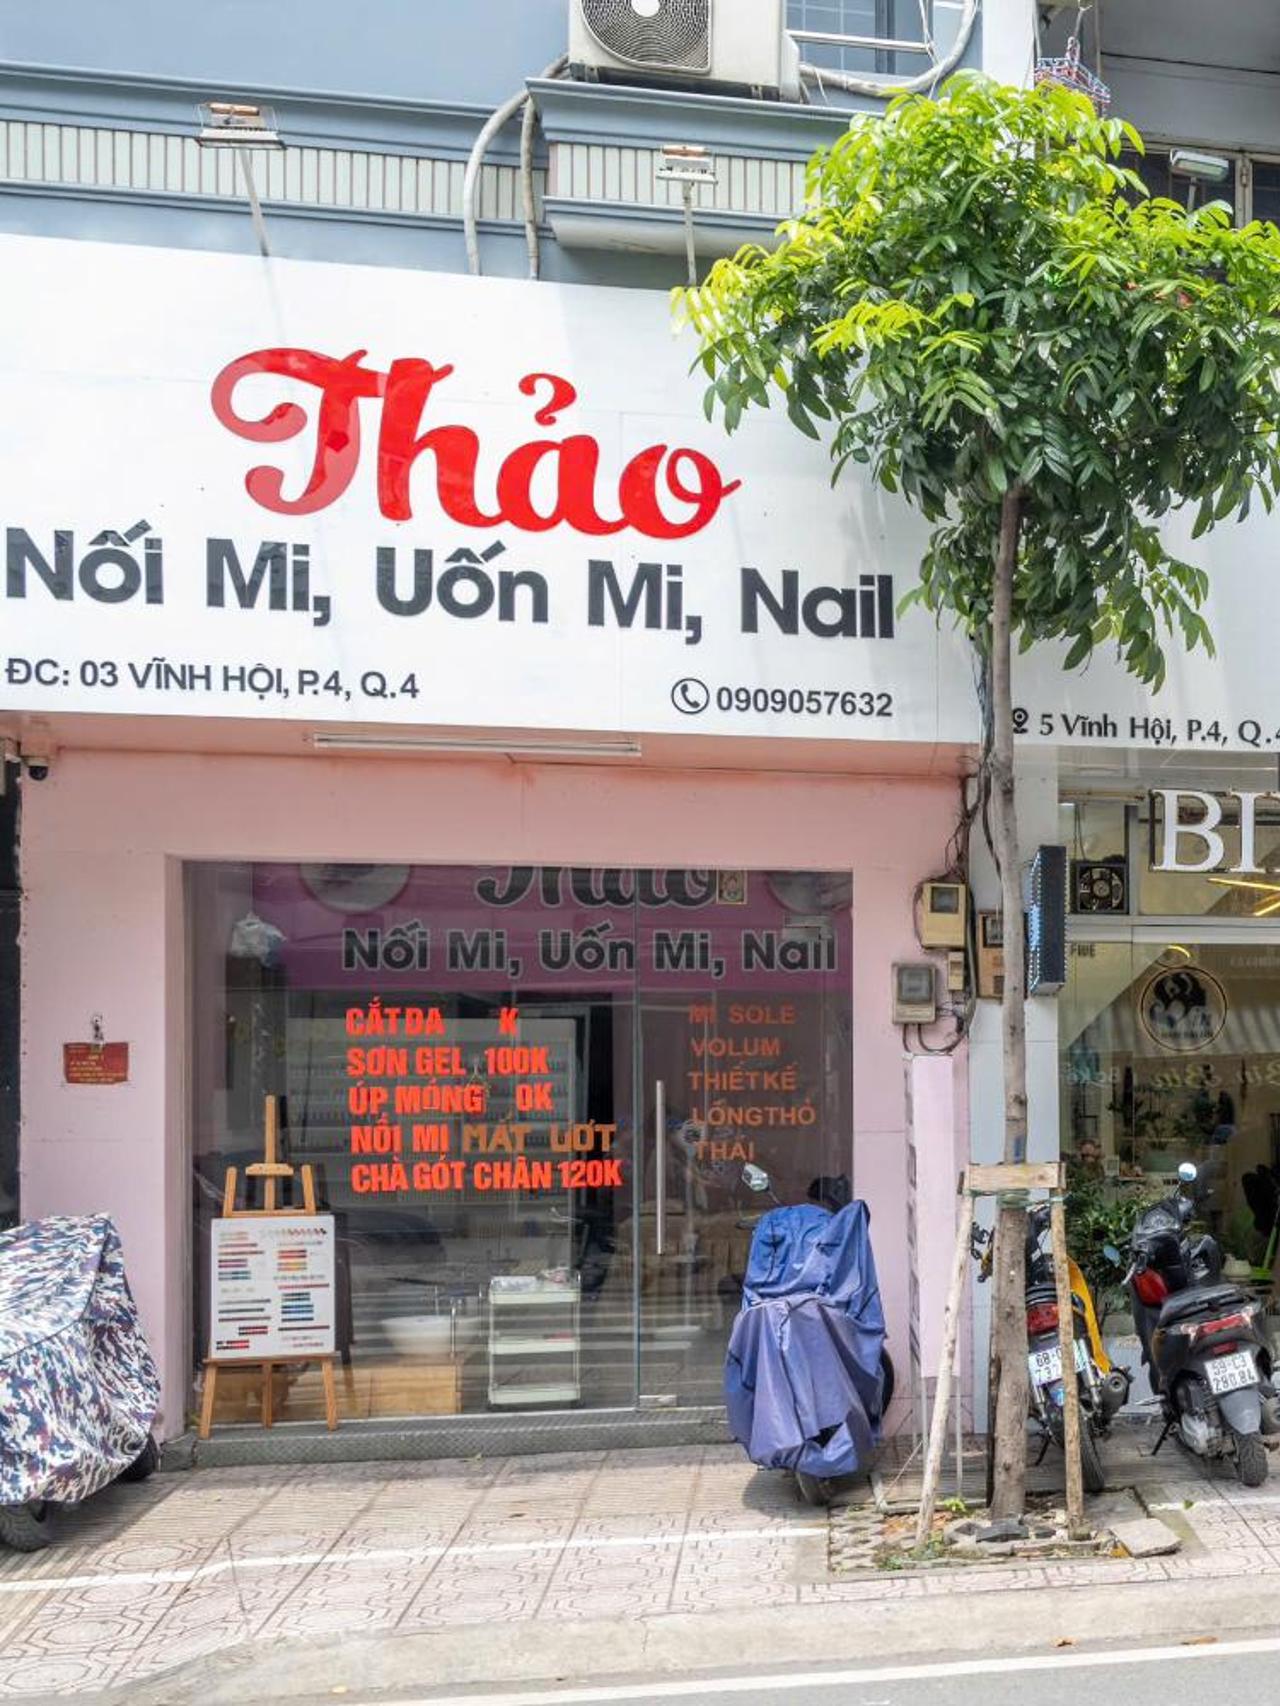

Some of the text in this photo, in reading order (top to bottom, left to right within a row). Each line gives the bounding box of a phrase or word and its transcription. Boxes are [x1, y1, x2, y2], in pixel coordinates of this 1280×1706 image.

[211, 347, 742, 539] Thảo
[6, 519, 895, 644] Nối Mi, Uốn Mi, Nail
[6, 657, 420, 701] ĐC: 03 VĨNH HỘI, P.4, Q.4
[716, 686, 893, 718] 0909057632
[1040, 714, 1053, 736] 5
[1060, 713, 1118, 738] Vĩnh
[1129, 717, 1177, 745] Hội,
[1187, 719, 1228, 745] P.4,
[343, 921, 837, 979] Nối Mi, Uốn Mi, Nail
[415, 1046, 467, 1077] GEL
[485, 1046, 550, 1077] 100K
[690, 1036, 781, 1058] VOLUM
[350, 1154, 624, 1193] CHÀ GÓT CHÂN 120K
